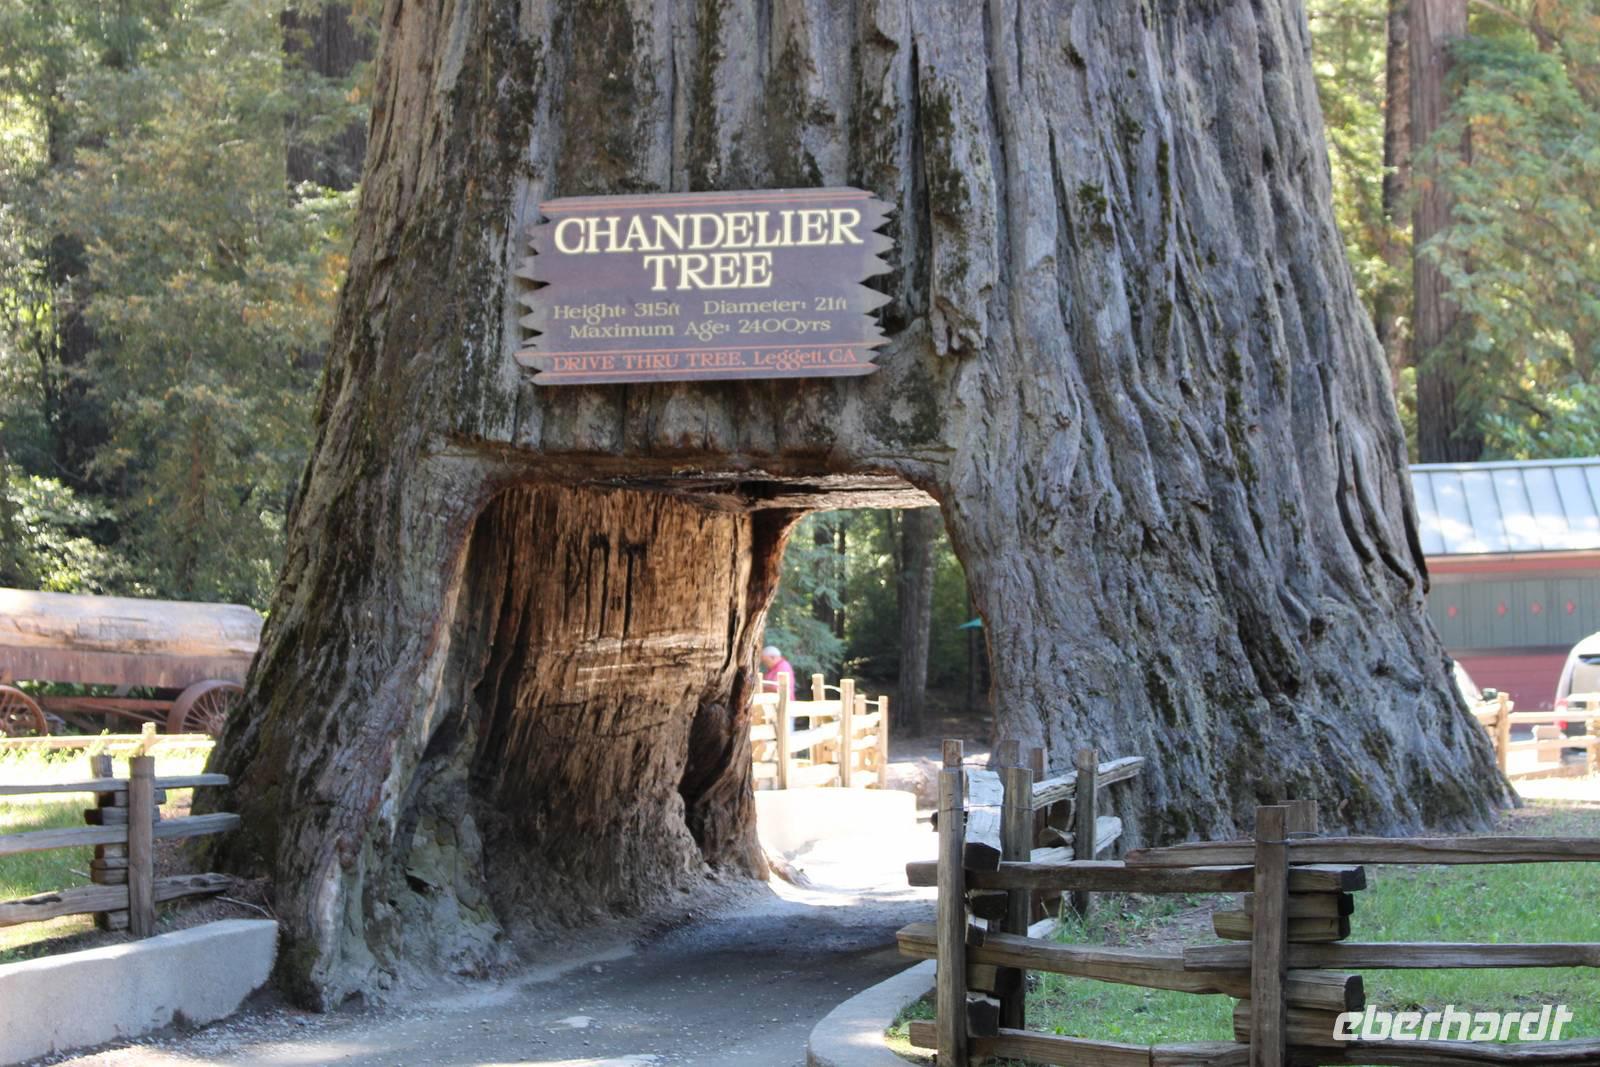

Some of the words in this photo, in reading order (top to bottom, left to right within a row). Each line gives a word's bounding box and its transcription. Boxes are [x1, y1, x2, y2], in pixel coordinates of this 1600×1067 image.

[554, 208, 864, 254] CHANDELIER
[643, 251, 773, 291] TREE
[553, 303, 627, 325] Height:
[634, 301, 681, 317] 315ft
[703, 298, 807, 315] Diameter:
[814, 296, 848, 312] 21ft
[569, 323, 674, 339] Maximum
[684, 320, 730, 342] Age:
[738, 317, 832, 335] 2400yrs
[553, 355, 615, 371] DRIVE
[622, 353, 679, 369] THRU
[828, 348, 858, 364] CA
